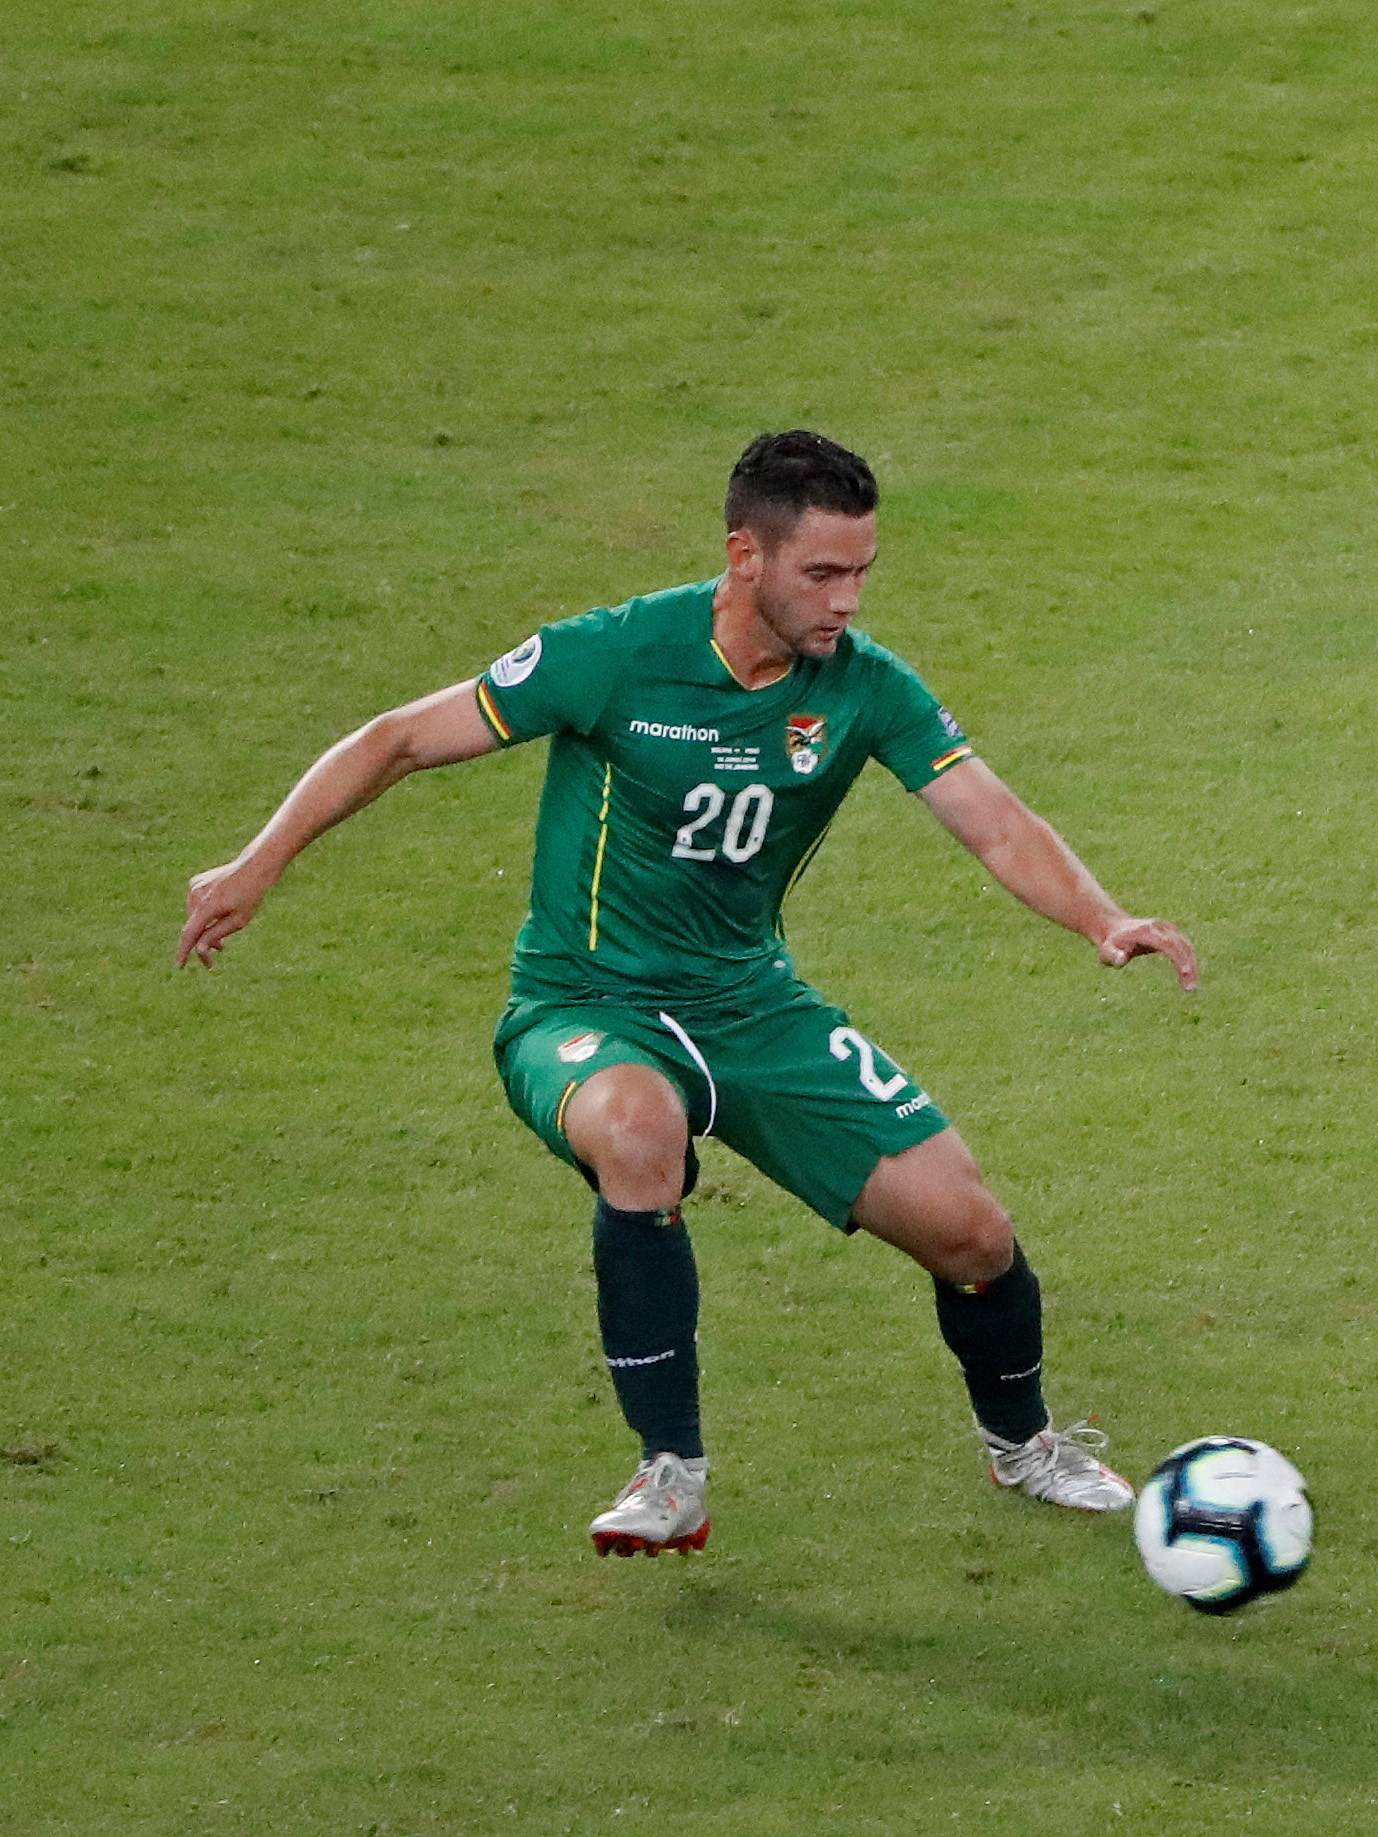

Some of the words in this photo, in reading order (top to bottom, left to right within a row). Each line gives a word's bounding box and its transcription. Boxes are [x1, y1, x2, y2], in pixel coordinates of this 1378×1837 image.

[629, 719, 720, 743] marathon
[671, 782, 775, 863] 20
[829, 1026, 908, 1102] 2
